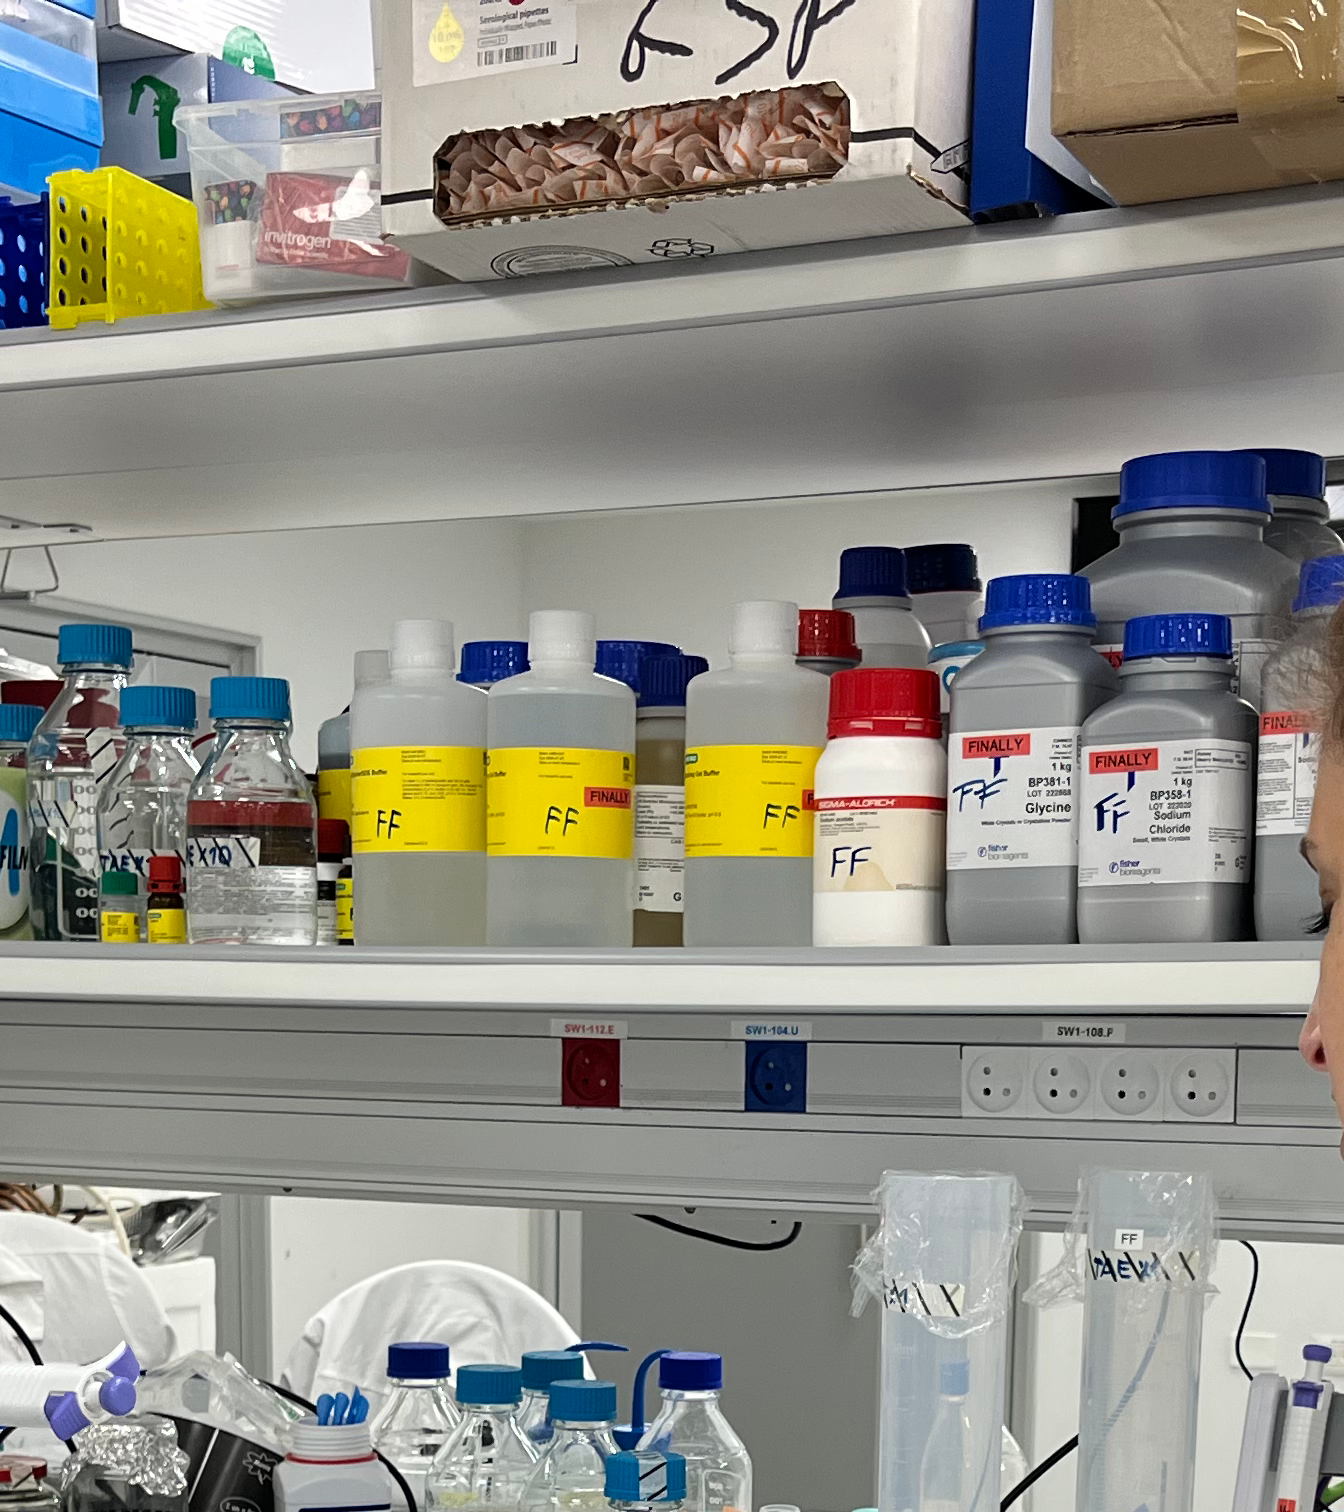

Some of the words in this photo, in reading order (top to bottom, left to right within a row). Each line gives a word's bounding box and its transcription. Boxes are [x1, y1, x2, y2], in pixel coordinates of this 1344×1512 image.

[264, 227, 331, 250] invitrogen
[968, 737, 1024, 754] FINALLY
[1095, 752, 1152, 769] FINALLY
[1052, 762, 1057, 771] 1
[1059, 762, 1072, 772] kg
[1028, 776, 1072, 788] BP381-1
[1173, 777, 1178, 786] 1
[1181, 777, 1193, 788] kg
[590, 790, 630, 804] FINALLY
[1027, 790, 1042, 798] LOT
[1150, 790, 1192, 801] BP358-1
[818, 798, 896, 810] SIGMA-ALDRICH
[1025, 802, 1072, 816] Glycine
[1149, 803, 1164, 811] LOT
[545, 805, 579, 837] FF
[763, 803, 801, 830] FF
[1153, 810, 1191, 821] Sodium
[377, 809, 402, 840] FF
[1149, 823, 1191, 835] Chloride
[831, 846, 872, 878] FF
[673, 891, 682, 902] G
[564, 1023, 615, 1036] SW1-112.E
[745, 1024, 800, 1036] SW1-104.U
[1120, 1233, 1138, 1245] FF
